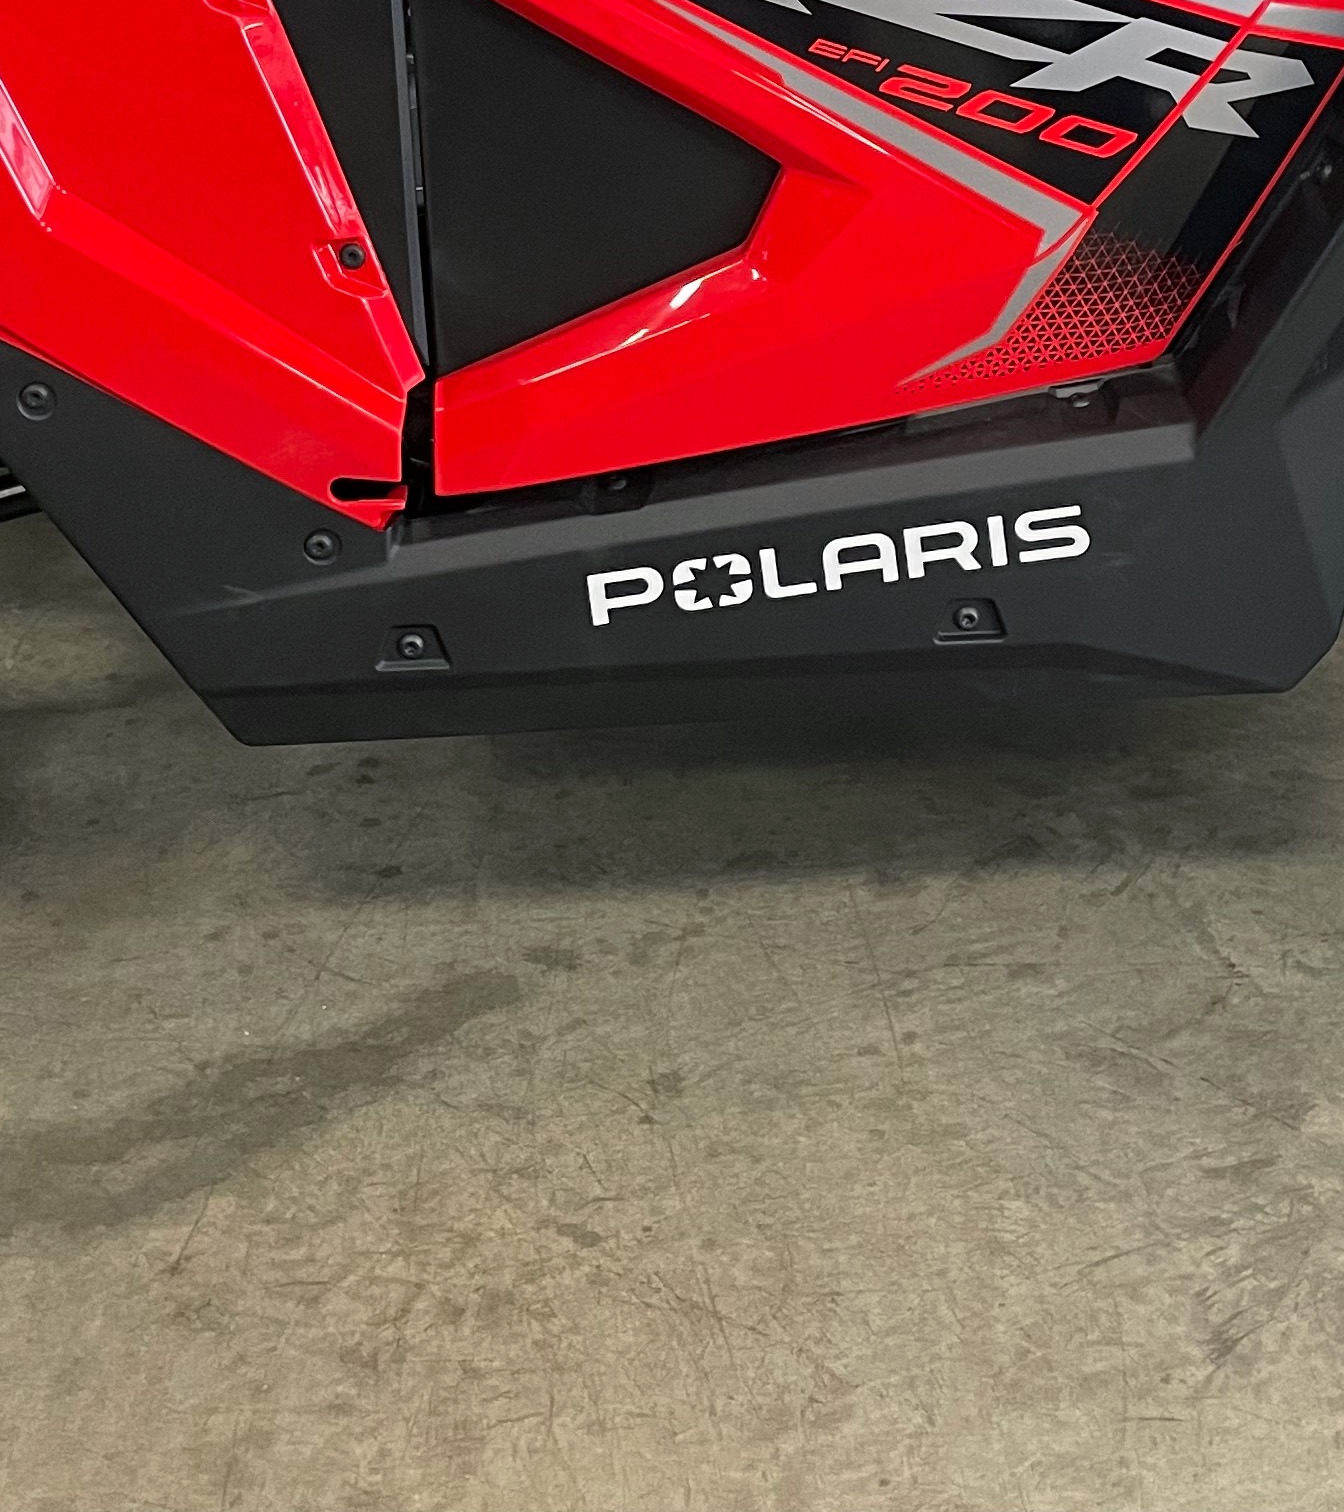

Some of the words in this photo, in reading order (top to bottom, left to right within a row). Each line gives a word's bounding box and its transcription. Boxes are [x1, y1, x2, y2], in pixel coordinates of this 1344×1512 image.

[807, 38, 889, 72] EFI
[879, 63, 1138, 159] 200
[586, 505, 1091, 626] POLARIS
